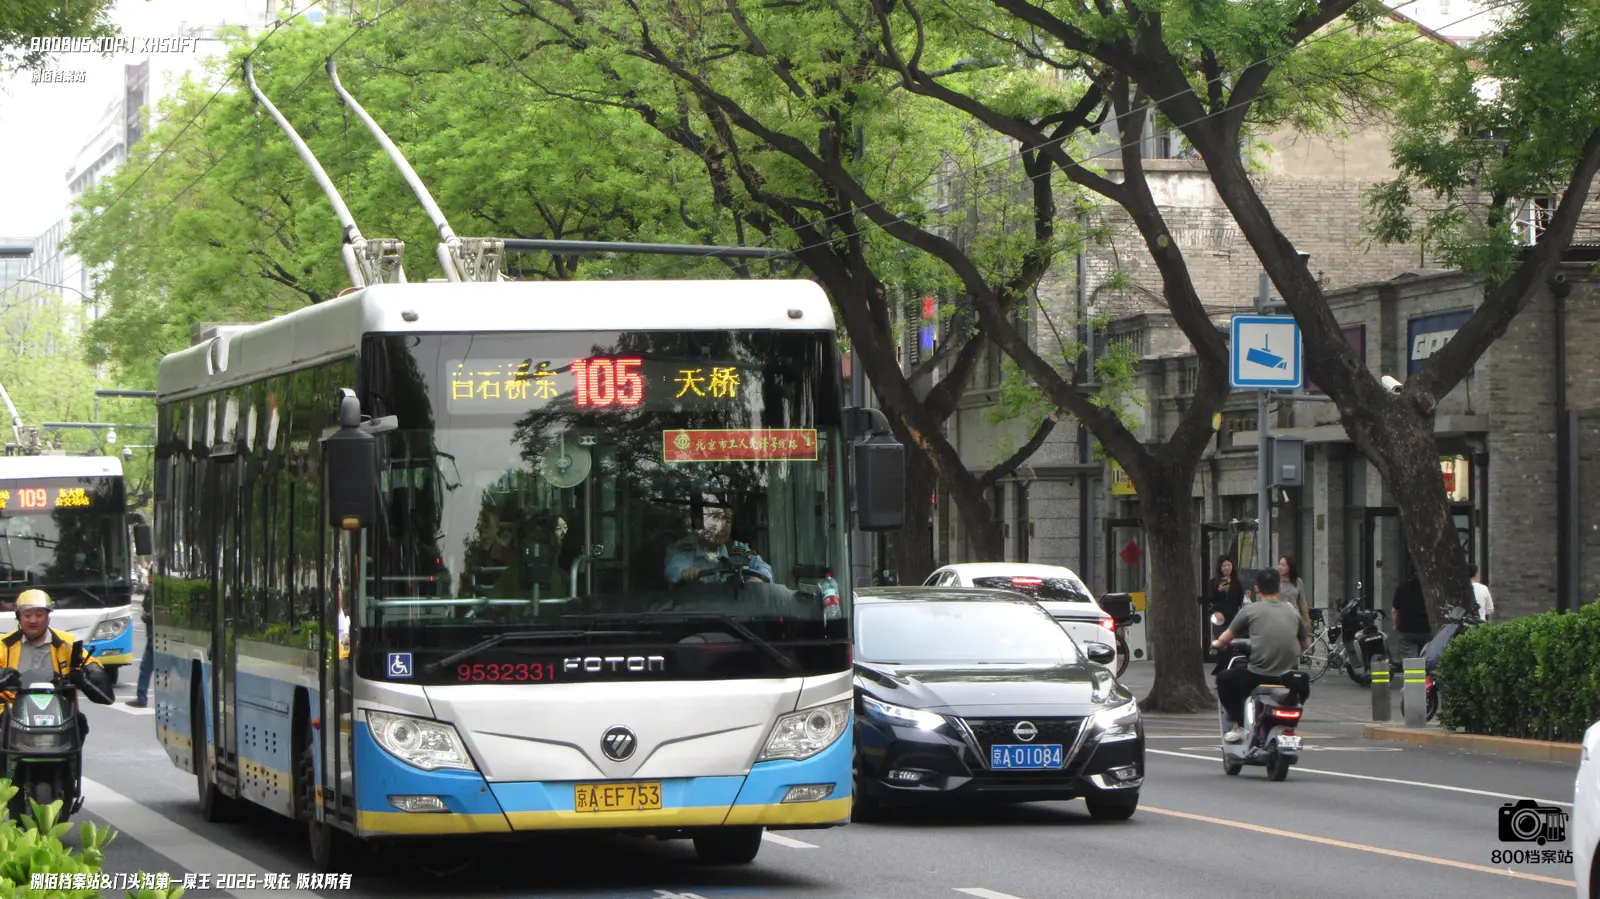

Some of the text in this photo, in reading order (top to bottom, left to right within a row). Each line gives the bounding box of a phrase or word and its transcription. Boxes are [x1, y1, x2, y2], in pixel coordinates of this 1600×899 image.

[452, 363, 558, 399] 白石桥东
[569, 358, 642, 405] 105
[674, 367, 740, 398] 天桥
[18, 488, 47, 508] 109
[457, 663, 555, 681] 9532331
[564, 656, 664, 672] FOTON
[993, 748, 1061, 765] 京A·01084
[577, 786, 660, 808] 京A·EF753
